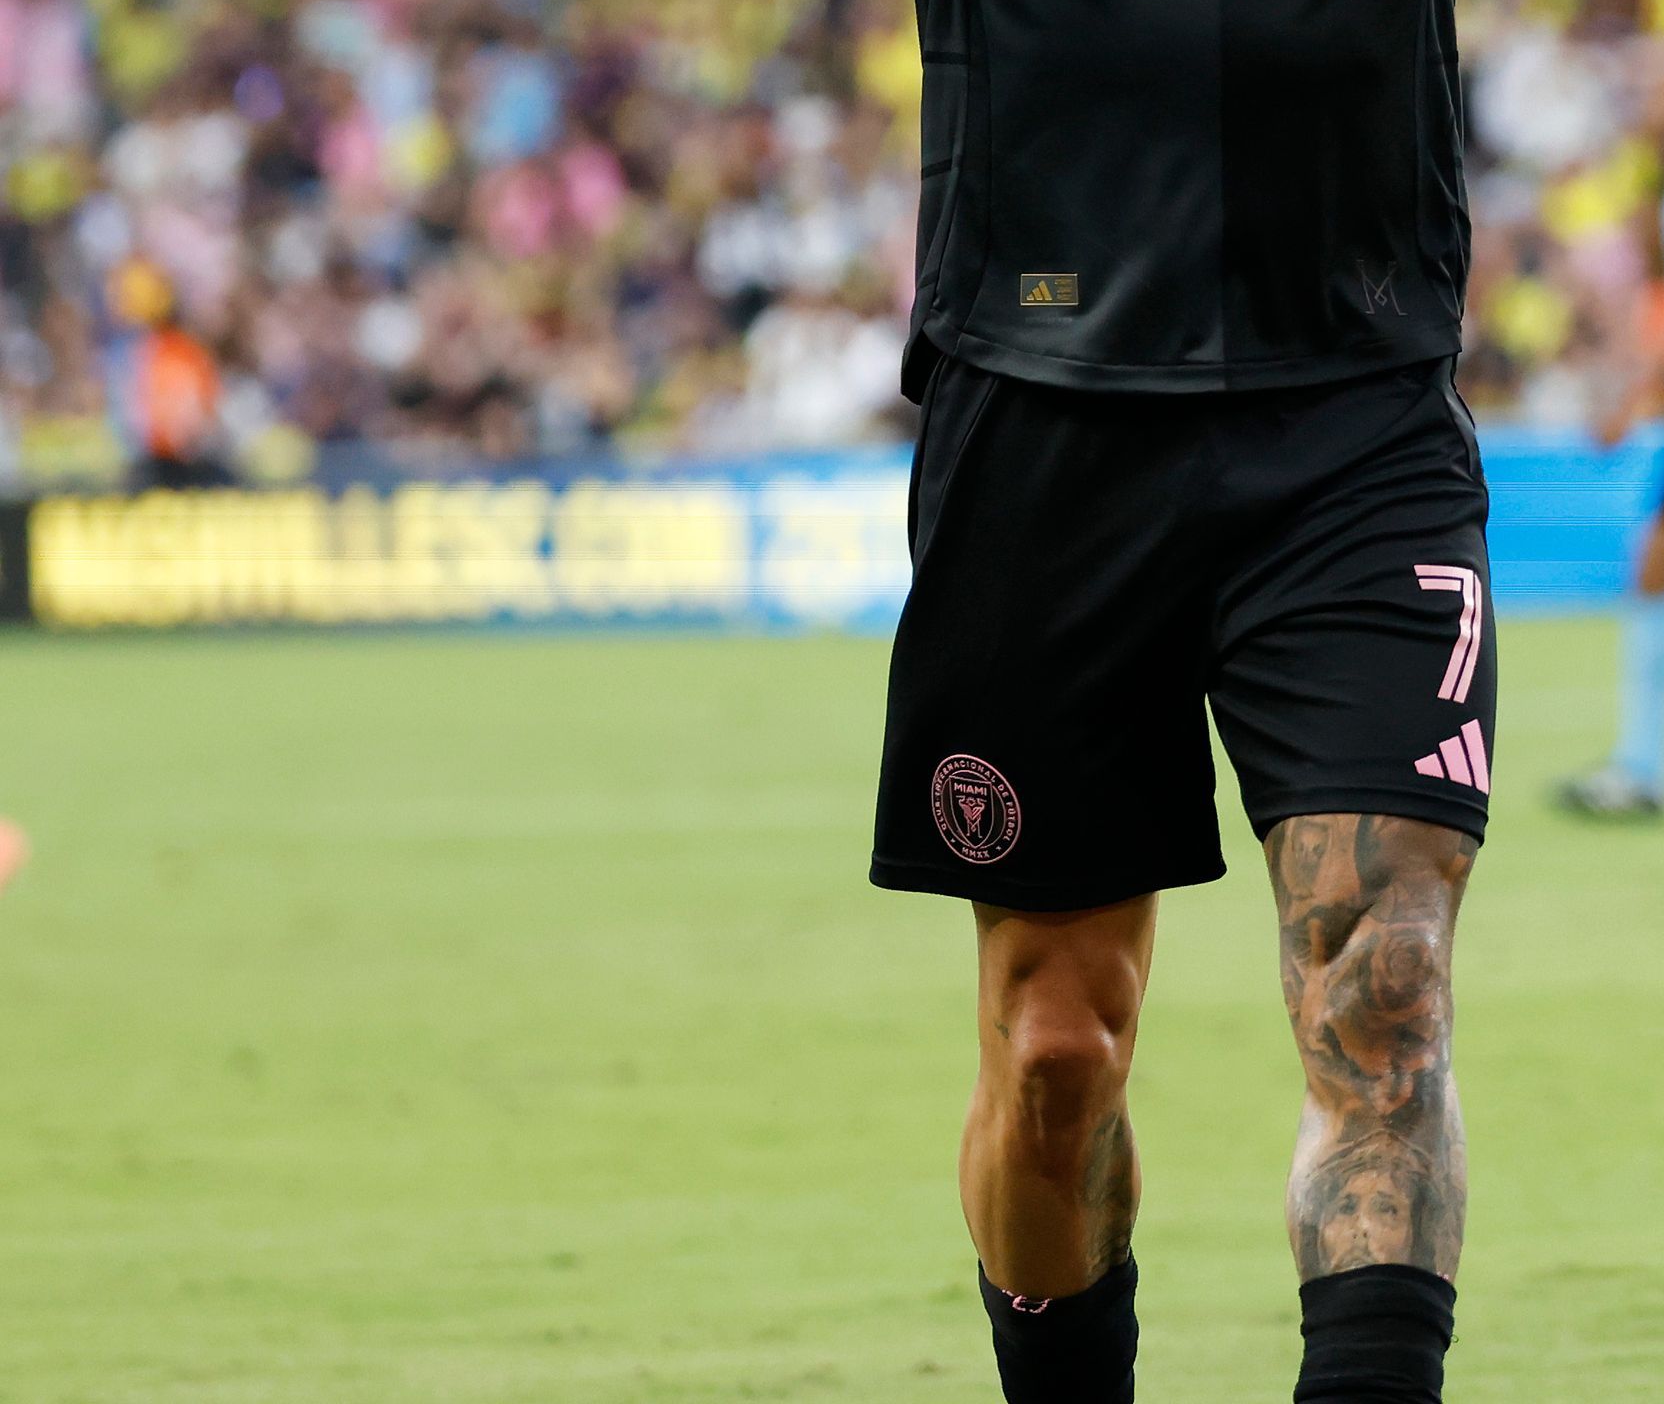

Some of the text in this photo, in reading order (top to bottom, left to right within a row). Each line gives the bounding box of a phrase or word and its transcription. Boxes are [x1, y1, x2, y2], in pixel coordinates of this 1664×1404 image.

[1414, 564, 1482, 704] 7
[935, 760, 996, 796] INTERNACIONAL
[998, 784, 1009, 798] DE
[954, 783, 987, 796] MIAMI
[962, 847, 990, 858] MMXX
